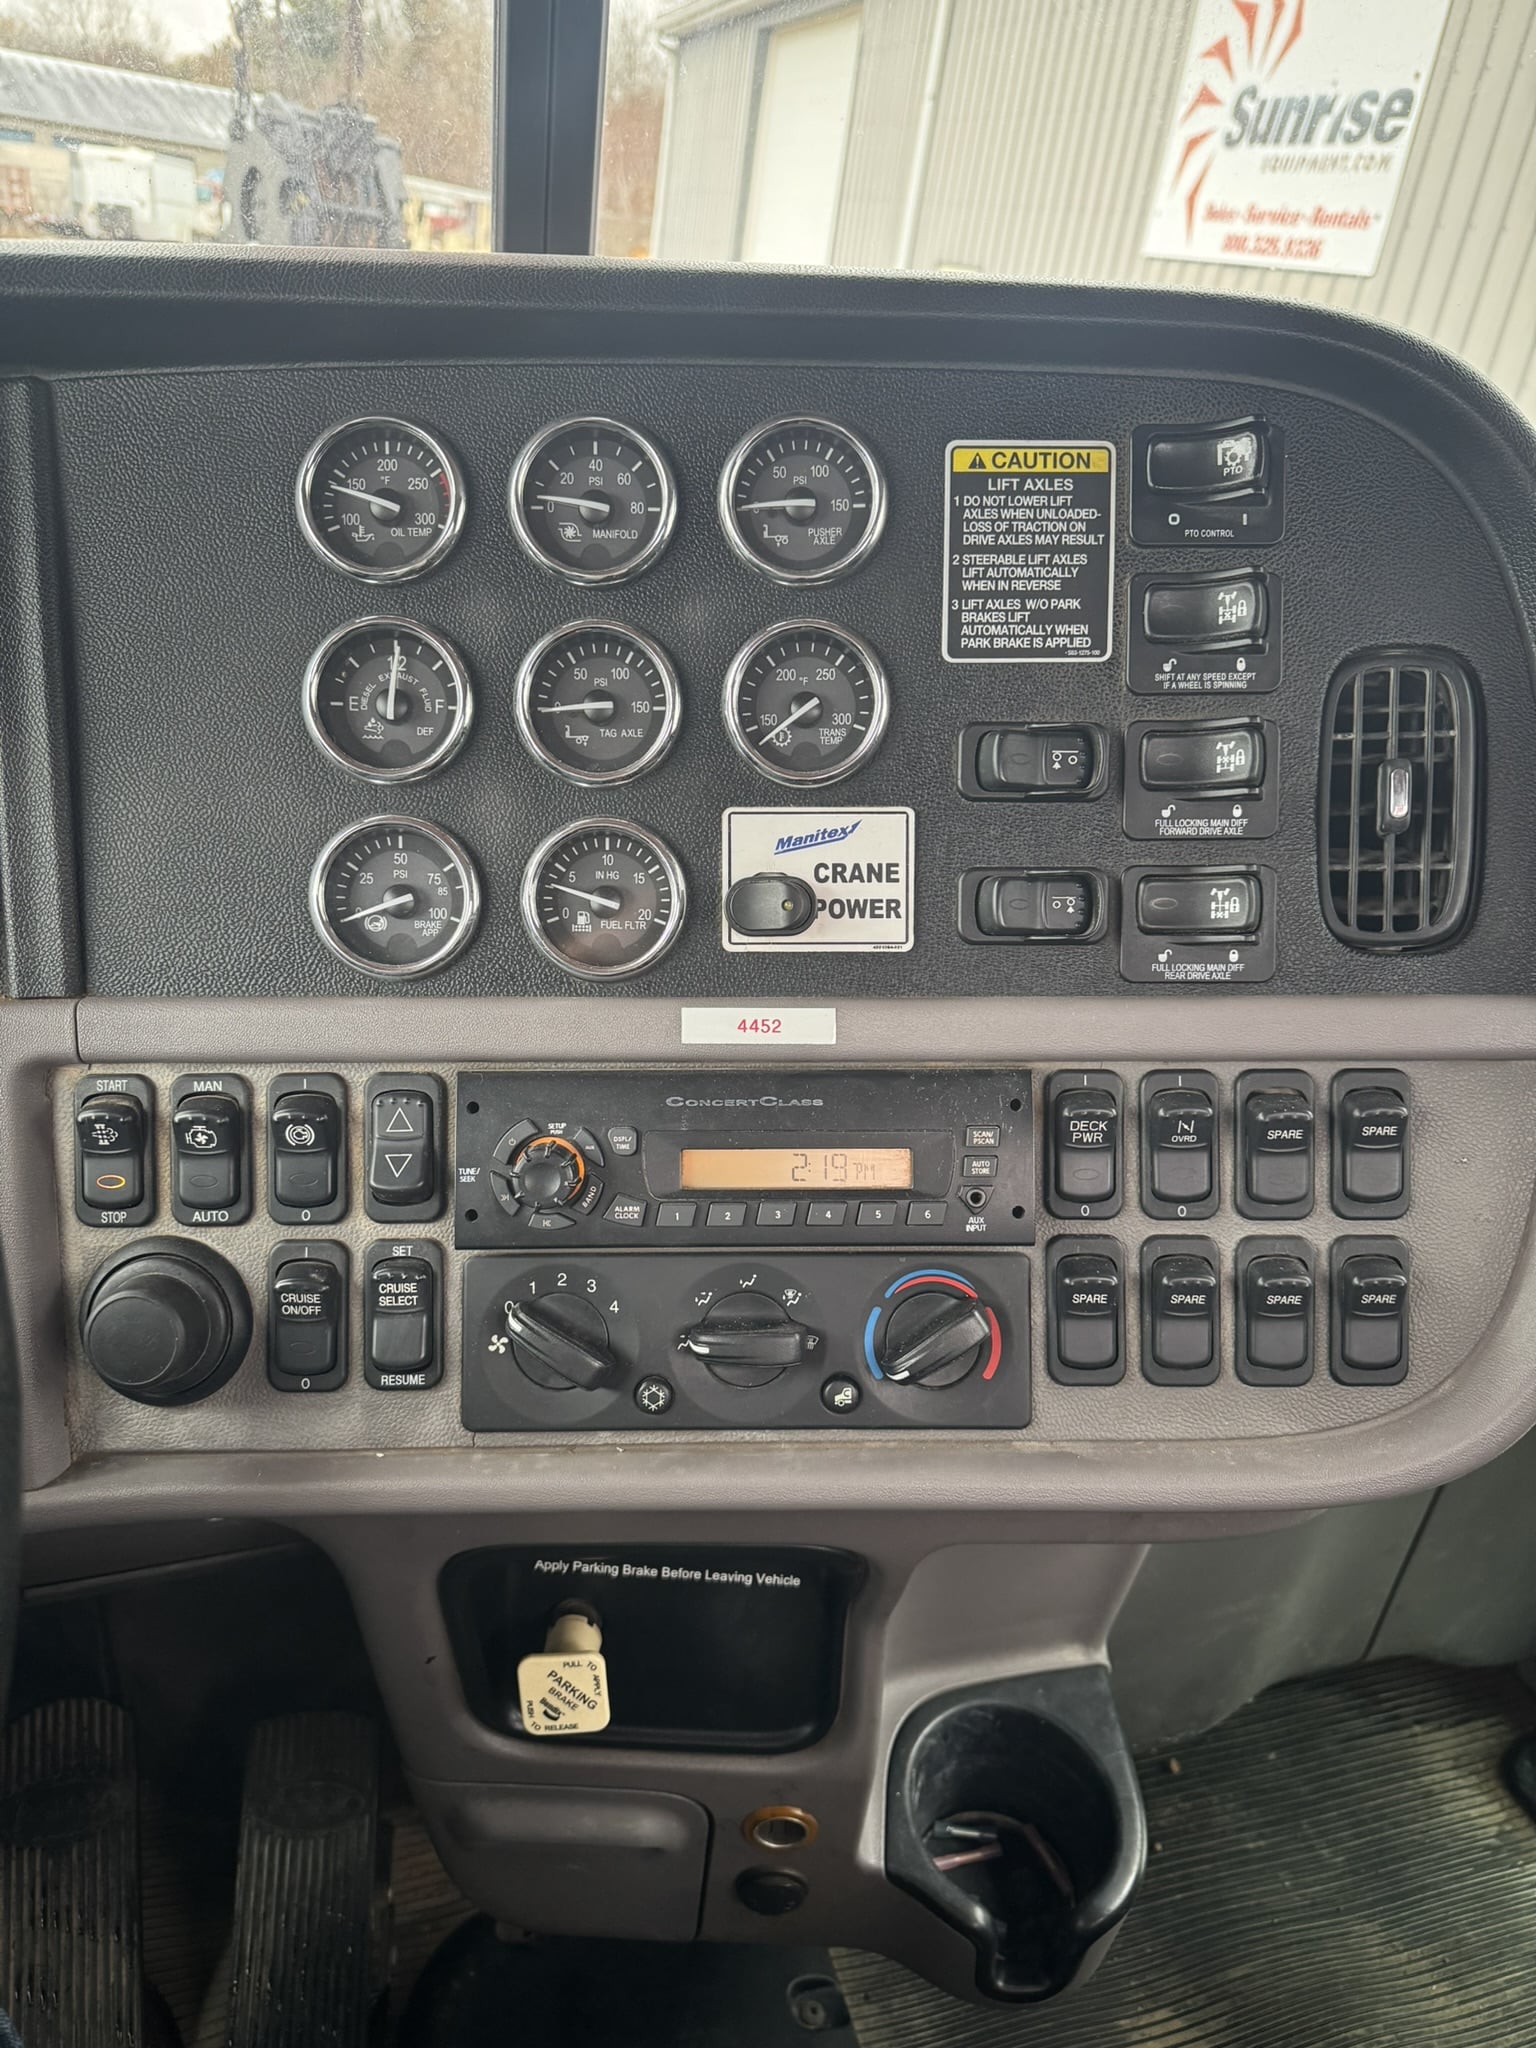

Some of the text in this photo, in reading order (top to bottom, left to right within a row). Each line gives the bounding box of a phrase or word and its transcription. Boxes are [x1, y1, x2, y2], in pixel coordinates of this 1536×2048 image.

[1225, 83, 1414, 149] Sunrise
[589, 459, 602, 471] 40
[992, 452, 1090, 469] CAUTION
[773, 467, 786, 478] 50
[811, 466, 829, 477] 100
[1224, 465, 1243, 476] PTO
[560, 473, 574, 484] 20
[618, 473, 631, 485] 60
[793, 476, 807, 484] PSI
[988, 479, 1073, 491] LIFT AXLES
[831, 499, 849, 511] 150
[954, 496, 1072, 506] 1 DO NOT LOWER LIFT
[631, 502, 643, 514] 80
[963, 509, 1101, 519] AXLES WHEN UNLOADED-
[391, 528, 432, 536] OIL TEMP
[808, 528, 842, 536] PUSHER
[963, 522, 1086, 532] LOSS OF TRACTION ON
[593, 530, 638, 539] MANIFOLD
[963, 534, 1104, 545] DRIVE AXLES MAY RESULT
[814, 536, 835, 544] AXLE
[953, 555, 1087, 565] 2 STEERABLE LIFT AXLES
[962, 568, 1079, 577] LIFT AUTOMATICALLY
[962, 580, 1061, 590] WHEN IN REVERSE
[952, 599, 1081, 609] 3 LIFT AXLES W/O PARK
[961, 612, 1030, 622] BRAKES LIFT
[961, 625, 1088, 635] AUTOMATICALLY WHEN
[961, 638, 1091, 648] PARK BRAKE IS APPLIED
[1155, 673, 1175, 681] SHIFT
[1178, 681, 1202, 689] WHEEL
[1204, 681, 1211, 689] IS
[361, 672, 431, 712] DIESEL EXAUST FLUID
[600, 729, 643, 737] TAG AXLE
[819, 728, 846, 736] TRANS
[1155, 819, 1173, 827] FULL
[1175, 819, 1208, 827] LOCKING
[1160, 827, 1243, 835] FORWARD DRIVE AXLE
[775, 825, 854, 851] Manitex
[394, 853, 407, 864] 50
[602, 855, 613, 865] 10
[814, 863, 899, 883] CRANE
[360, 873, 373, 884] 25
[428, 873, 441, 885] 75
[633, 873, 645, 884] 15
[429, 908, 447, 919] 100
[817, 899, 901, 919] POWER
[638, 909, 651, 921] 20
[415, 921, 442, 929] BRAKE
[601, 921, 646, 929] FUEL FLTR
[1165, 972, 1185, 980] REAR
[1187, 972, 1210, 980] DRIVE
[737, 1019, 782, 1033] 4452
[97, 1080, 128, 1091] START
[193, 1081, 222, 1091] MAN
[1070, 1121, 1108, 1131] DECK
[1362, 1126, 1398, 1136] SPARE
[1072, 1133, 1103, 1142] PWR
[1267, 1130, 1303, 1139] SPARE
[792, 1153, 847, 1181] 2:19
[582, 1186, 596, 1208] BAND
[101, 1212, 127, 1223] STOP
[192, 1211, 229, 1222] AUTO
[392, 1246, 413, 1256] SET
[558, 1273, 567, 1286] 2
[379, 1283, 417, 1293] CRUISE
[587, 1280, 597, 1292] 3
[281, 1293, 321, 1303] CRUISE
[379, 1296, 418, 1306] SELECT
[1072, 1294, 1108, 1303] SPARE
[1170, 1295, 1206, 1304] SPARE
[1266, 1296, 1302, 1304] SPARE
[1361, 1295, 1397, 1303] SPARE
[282, 1305, 321, 1315] ON/OFF
[609, 1300, 619, 1313] 4
[381, 1375, 425, 1385] RESUME
[534, 1560, 800, 1586] Apply Parking Brake Before Leaving Vehicle
[587, 1661, 597, 1671] TO
[593, 1674, 601, 1696] APPLY
[547, 1670, 598, 1710] PARKING
[548, 1687, 579, 1711] BRAKE
[531, 1722, 541, 1730] TO
